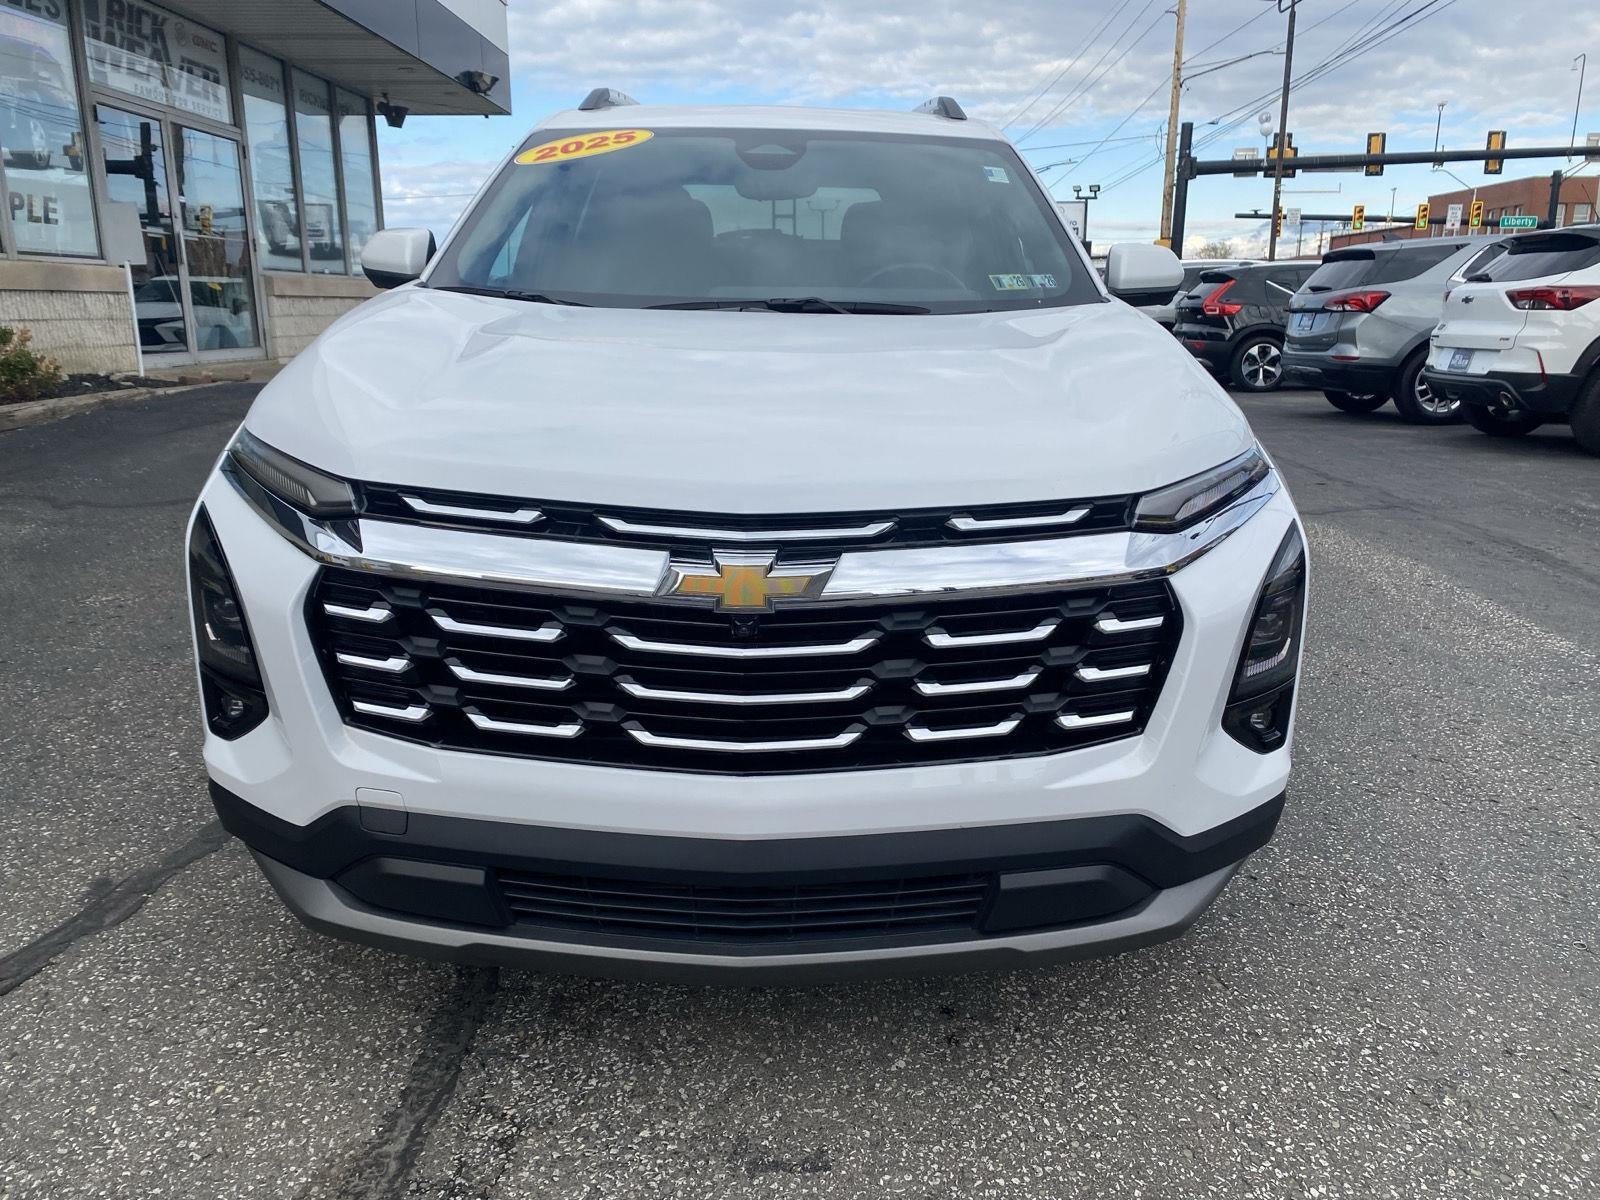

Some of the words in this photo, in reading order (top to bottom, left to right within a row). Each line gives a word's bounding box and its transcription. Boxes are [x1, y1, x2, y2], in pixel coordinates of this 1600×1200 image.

[533, 131, 637, 162] 2025
[9, 192, 59, 225] PLE
[1504, 217, 1533, 227] Liberty
